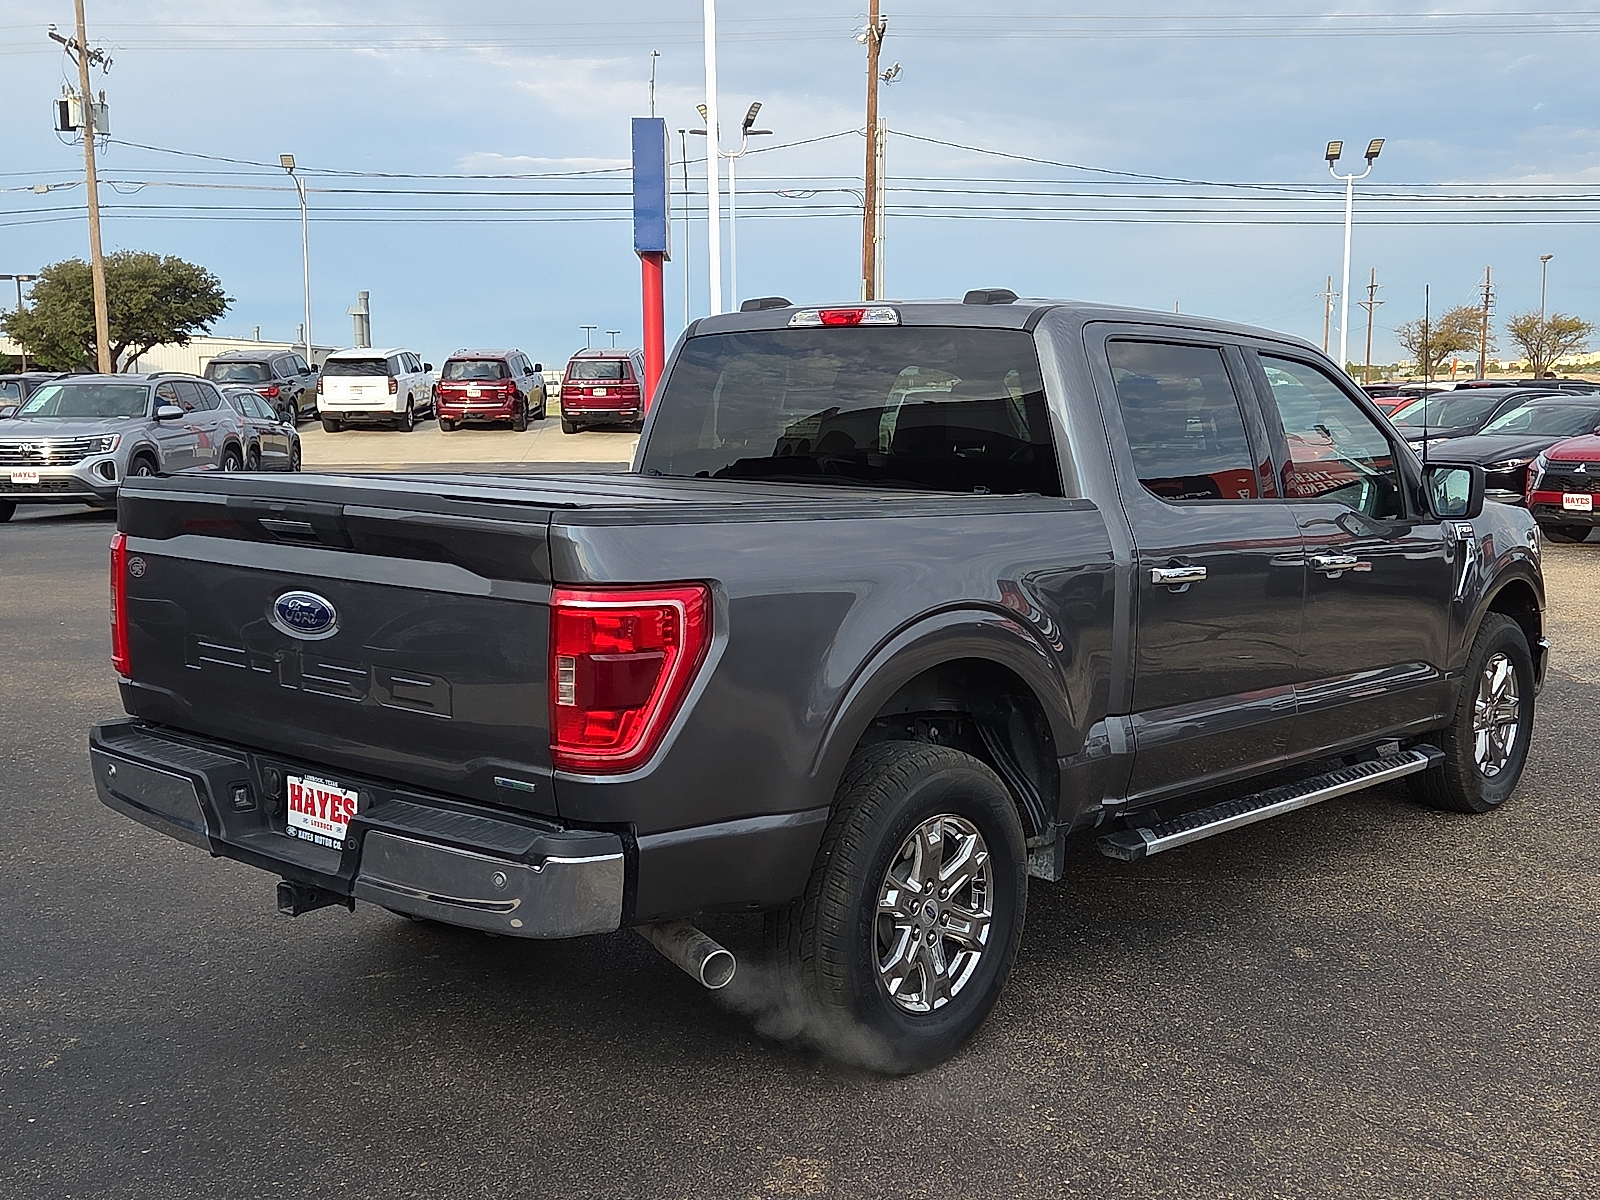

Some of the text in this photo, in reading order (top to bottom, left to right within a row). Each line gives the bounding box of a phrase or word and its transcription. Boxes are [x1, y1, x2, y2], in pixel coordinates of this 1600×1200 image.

[1564, 496, 1590, 505] HAYES
[285, 599, 319, 625] Ford
[184, 634, 453, 719] F-150
[325, 779, 339, 788] TEXAS
[289, 782, 355, 825] HAYES
[310, 819, 333, 832] LUBBOCK
[297, 829, 343, 851] HAYES MOTOR CO.
